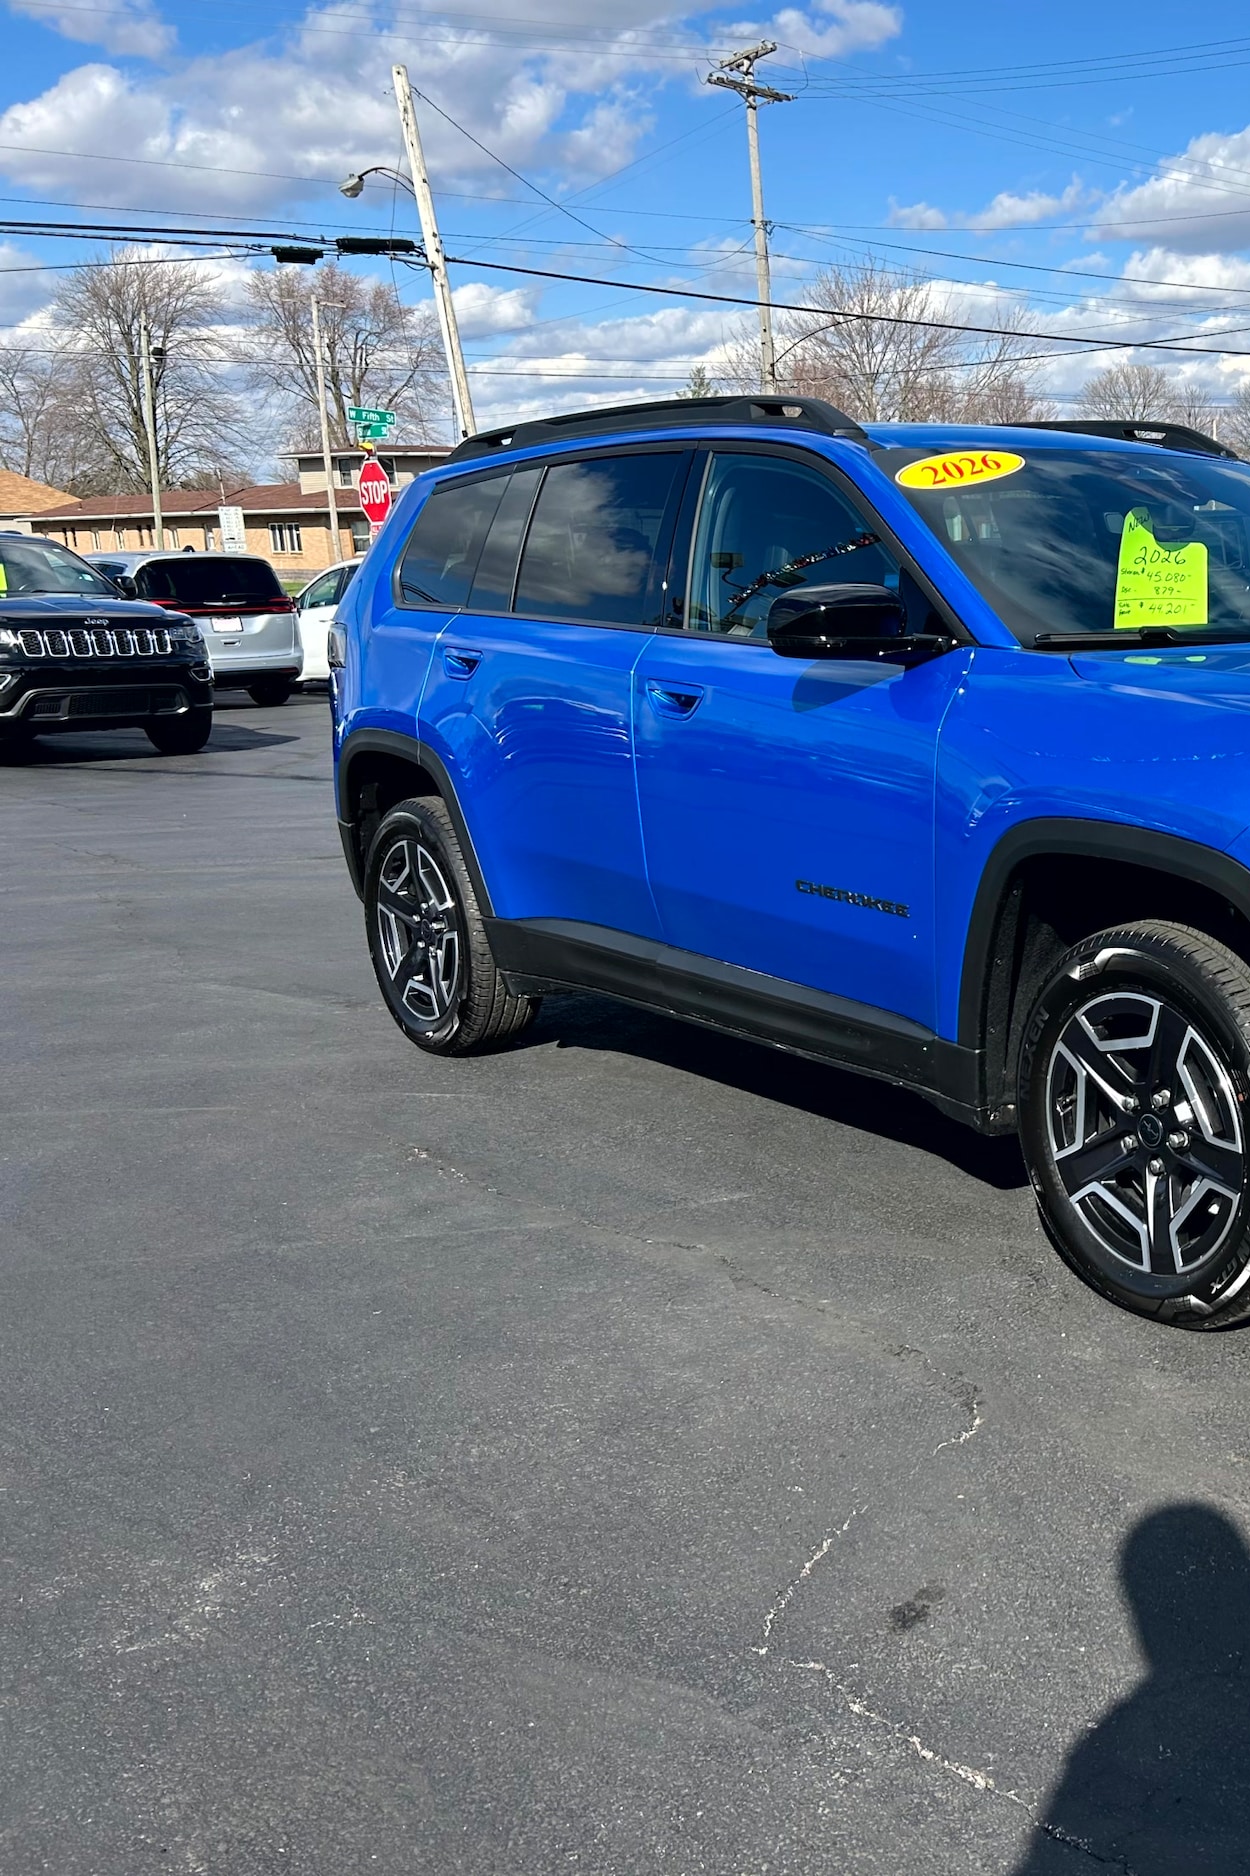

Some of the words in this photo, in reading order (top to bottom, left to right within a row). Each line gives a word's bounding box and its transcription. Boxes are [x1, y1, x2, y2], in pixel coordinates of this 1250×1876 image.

[349, 410, 356, 418] W
[362, 411, 380, 421] Fifth
[385, 414, 394, 423] St
[921, 454, 1002, 485] 2026
[360, 480, 388, 505] STOP
[1134, 546, 1186, 565] 2026
[84, 617, 110, 626] Jeep
[796, 880, 910, 919] CHEROKEE
[1020, 1005, 1050, 1101] NEXEN
